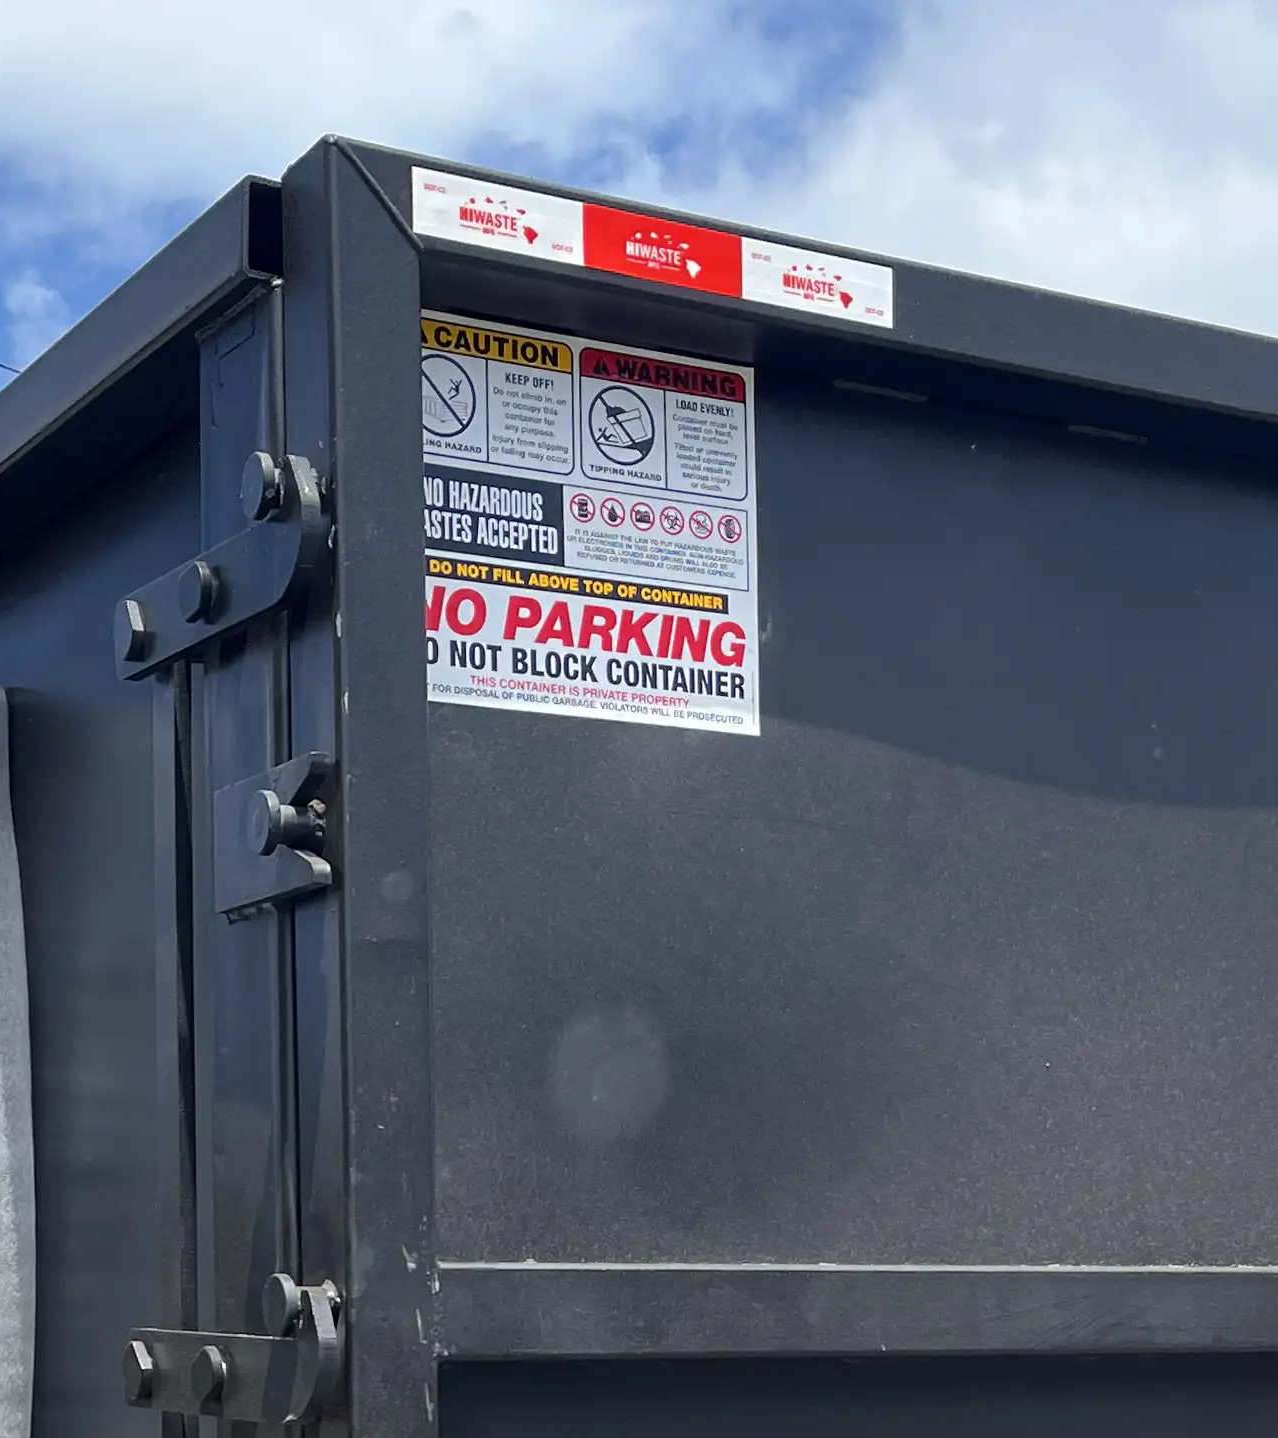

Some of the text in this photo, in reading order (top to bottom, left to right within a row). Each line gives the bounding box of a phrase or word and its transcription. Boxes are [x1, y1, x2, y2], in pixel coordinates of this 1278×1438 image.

[434, 326, 559, 367] CAUTION
[505, 372, 554, 391] KEEP OFF!
[615, 359, 737, 398] WARNING
[513, 403, 541, 413] occupy
[676, 399, 734, 417] LOAD EVENLY!
[423, 439, 482, 453] ING HAZARD
[517, 438, 535, 446] from
[590, 464, 662, 482] TIPPING HAZARD
[449, 480, 543, 521] HAZARDOUS
[424, 508, 558, 555] ASTES ACCEPTED
[430, 560, 723, 609] DO NOT FILL ABOVE TOP OF CONTAINER
[503, 595, 746, 668] PARKING
[450, 639, 502, 672] NOT
[512, 647, 598, 683] BLOCK
[606, 658, 745, 699] CONTAINER
[432, 684, 451, 693] FOR
[454, 687, 499, 698] DISPOSAL
[502, 692, 514, 700] OF
[517, 694, 550, 704] PUBLIC
[601, 702, 648, 714] VIOLATORS
[651, 708, 671, 717] WILL
[674, 710, 684, 718] BE
[687, 711, 743, 724] PROSECUTED
[470, 675, 690, 708] THIS CONTAINER IS PRIVATE PROPERTY
